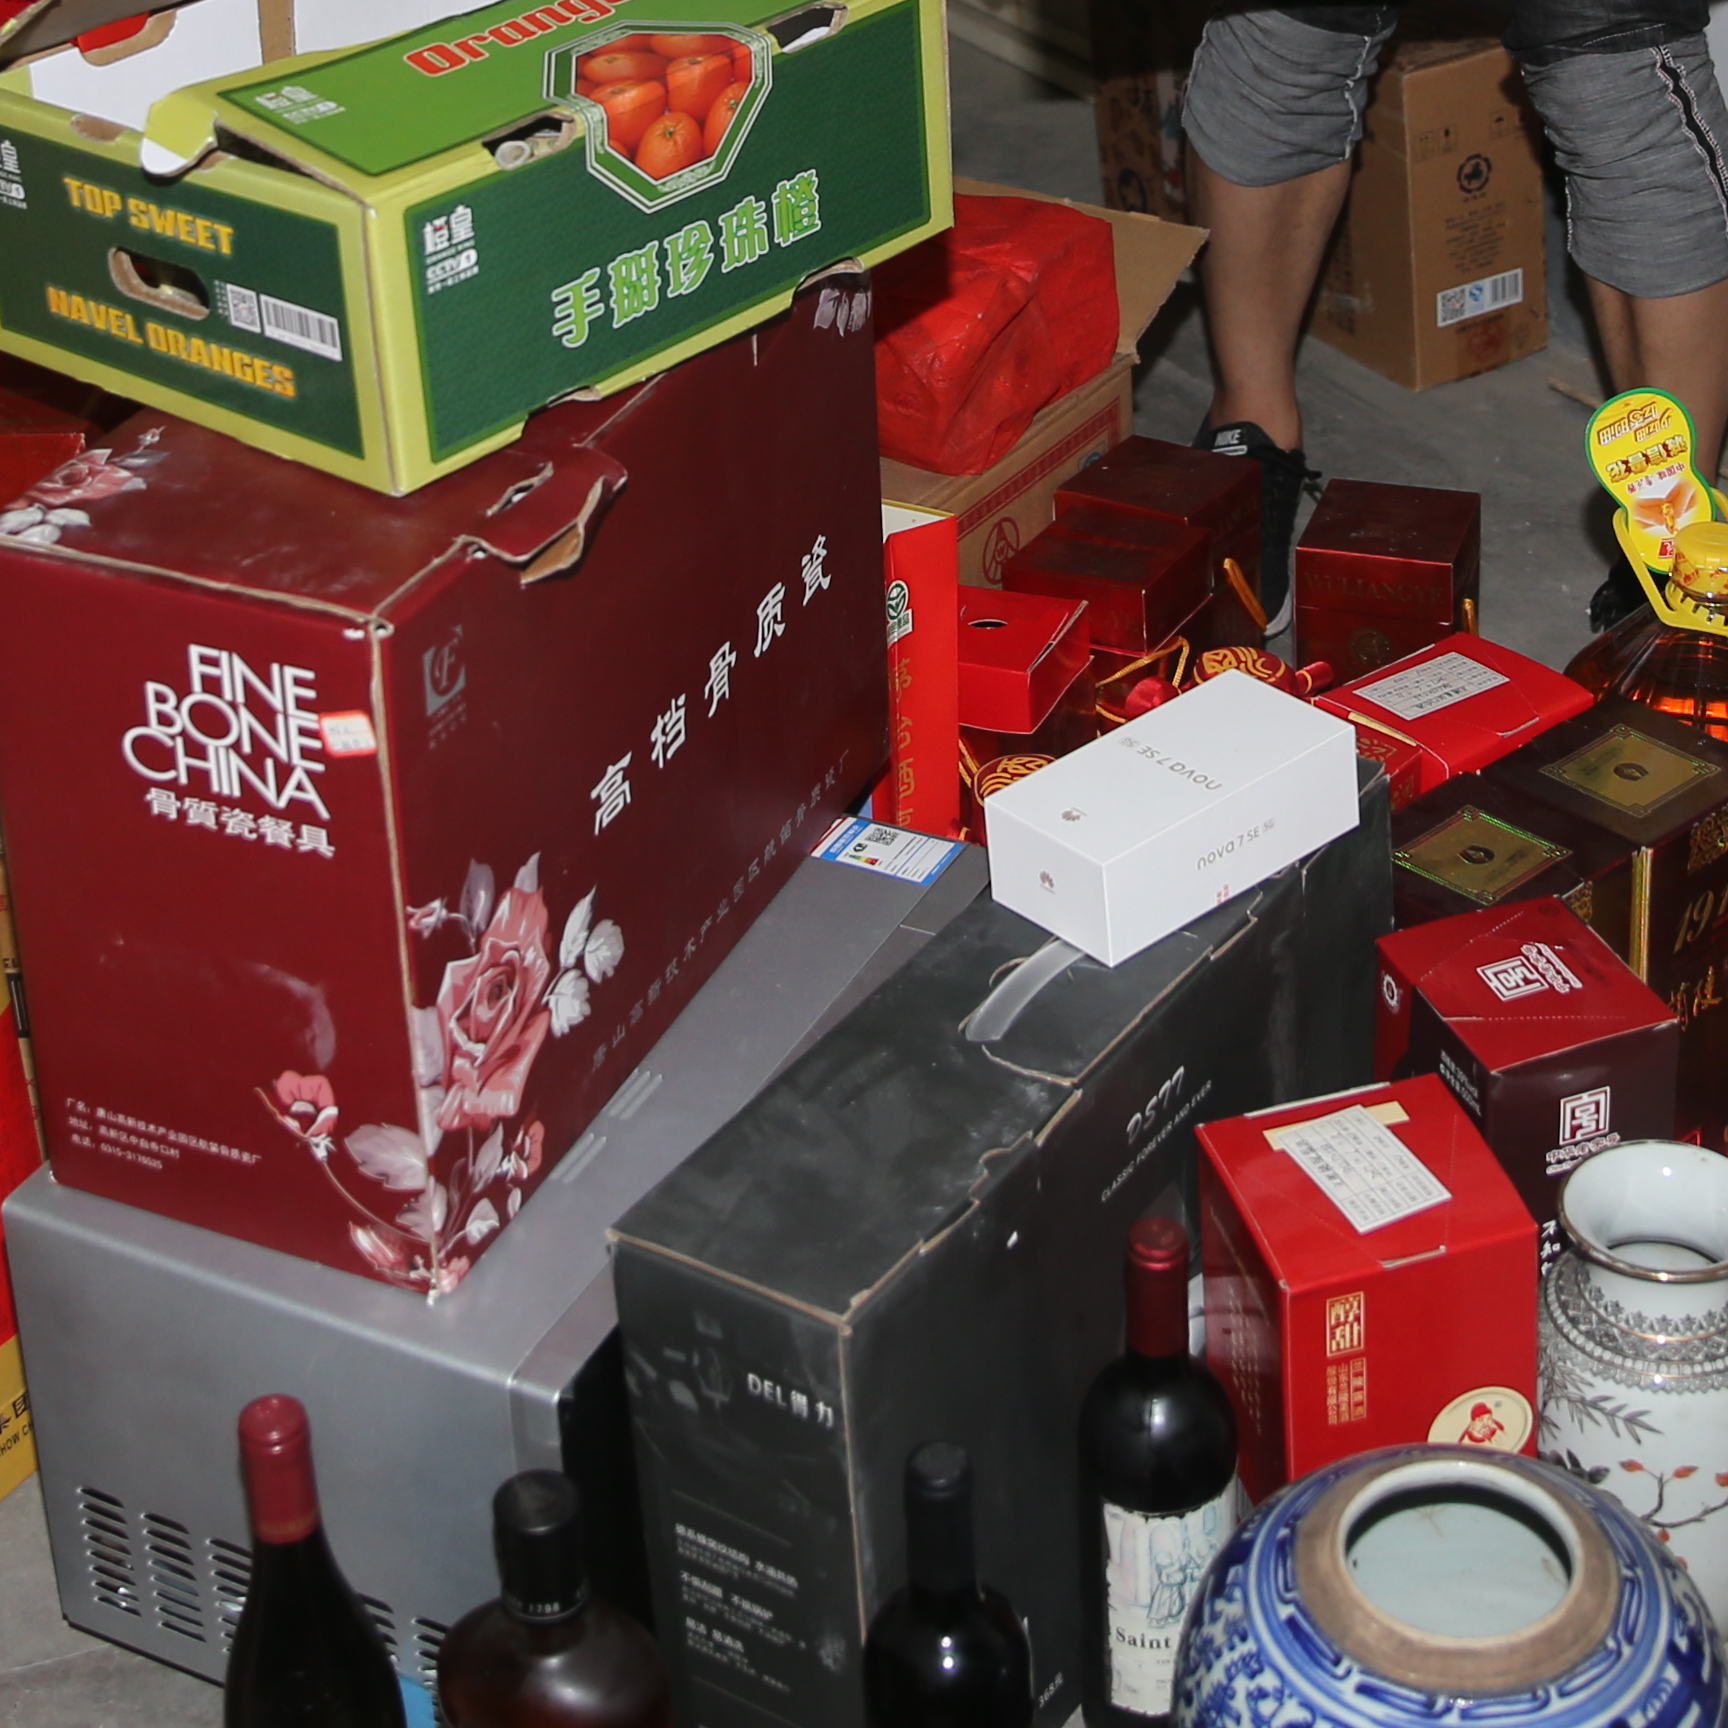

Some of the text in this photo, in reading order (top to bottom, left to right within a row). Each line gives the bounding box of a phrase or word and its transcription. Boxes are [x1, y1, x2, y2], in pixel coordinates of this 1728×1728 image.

[63, 177, 234, 256] TOP SWEET
[45, 287, 297, 398] NAVEL ORANGES
[1304, 572, 1445, 605] WULIANGYE
[145, 681, 327, 774] BONE
[188, 643, 319, 726] FINE
[591, 534, 834, 837] 高档骨质瓷
[121, 725, 331, 821] CHINA
[1196, 839, 1236, 872] nova
[1236, 833, 1245, 849] 7
[1246, 825, 1261, 843] SE
[1101, 1079, 1212, 1203] CLASSIC FOREVER AND EVER
[1115, 1626, 1171, 1649] Saint
